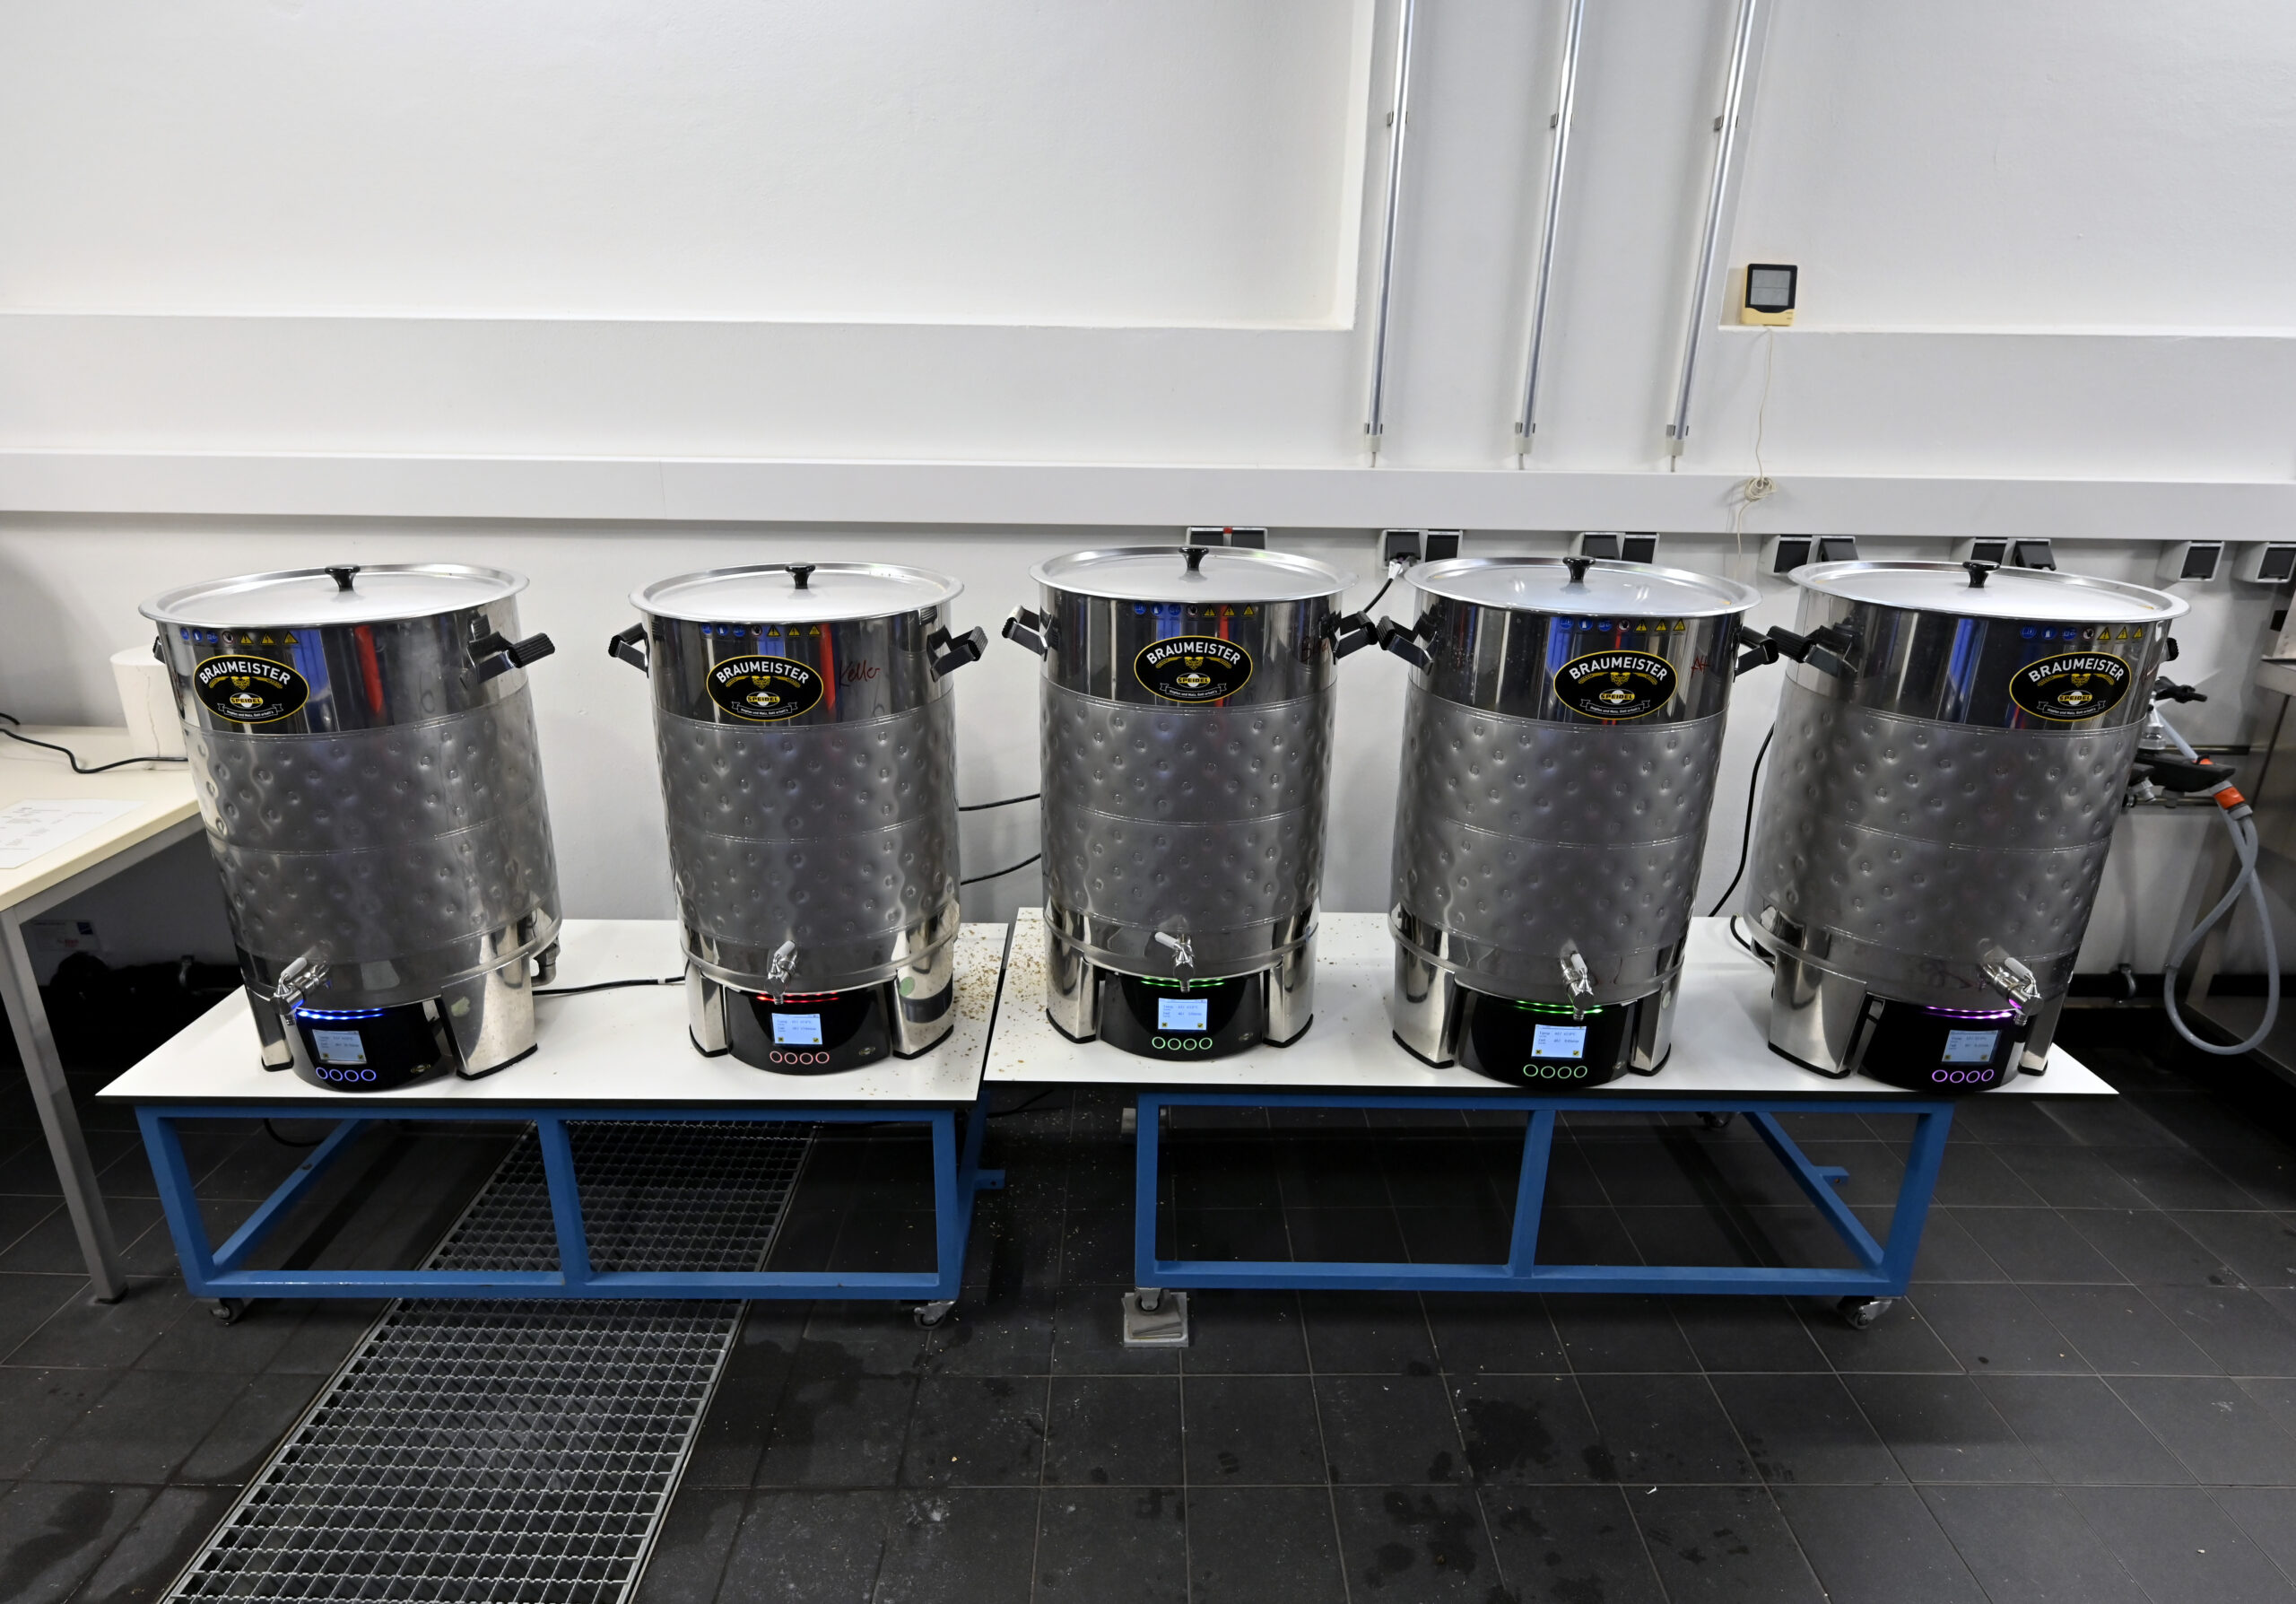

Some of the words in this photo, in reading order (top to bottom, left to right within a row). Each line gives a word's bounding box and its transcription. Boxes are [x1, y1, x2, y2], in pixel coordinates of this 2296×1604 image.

[1146, 641, 1240, 665] BRAUMEISTER
[199, 661, 291, 684] BRAUMEISTER
[716, 661, 809, 684] BRAUMEISTER
[1569, 657, 1667, 681] BRAUMEISTER
[2028, 658, 2125, 681] BRAUMEISTER
